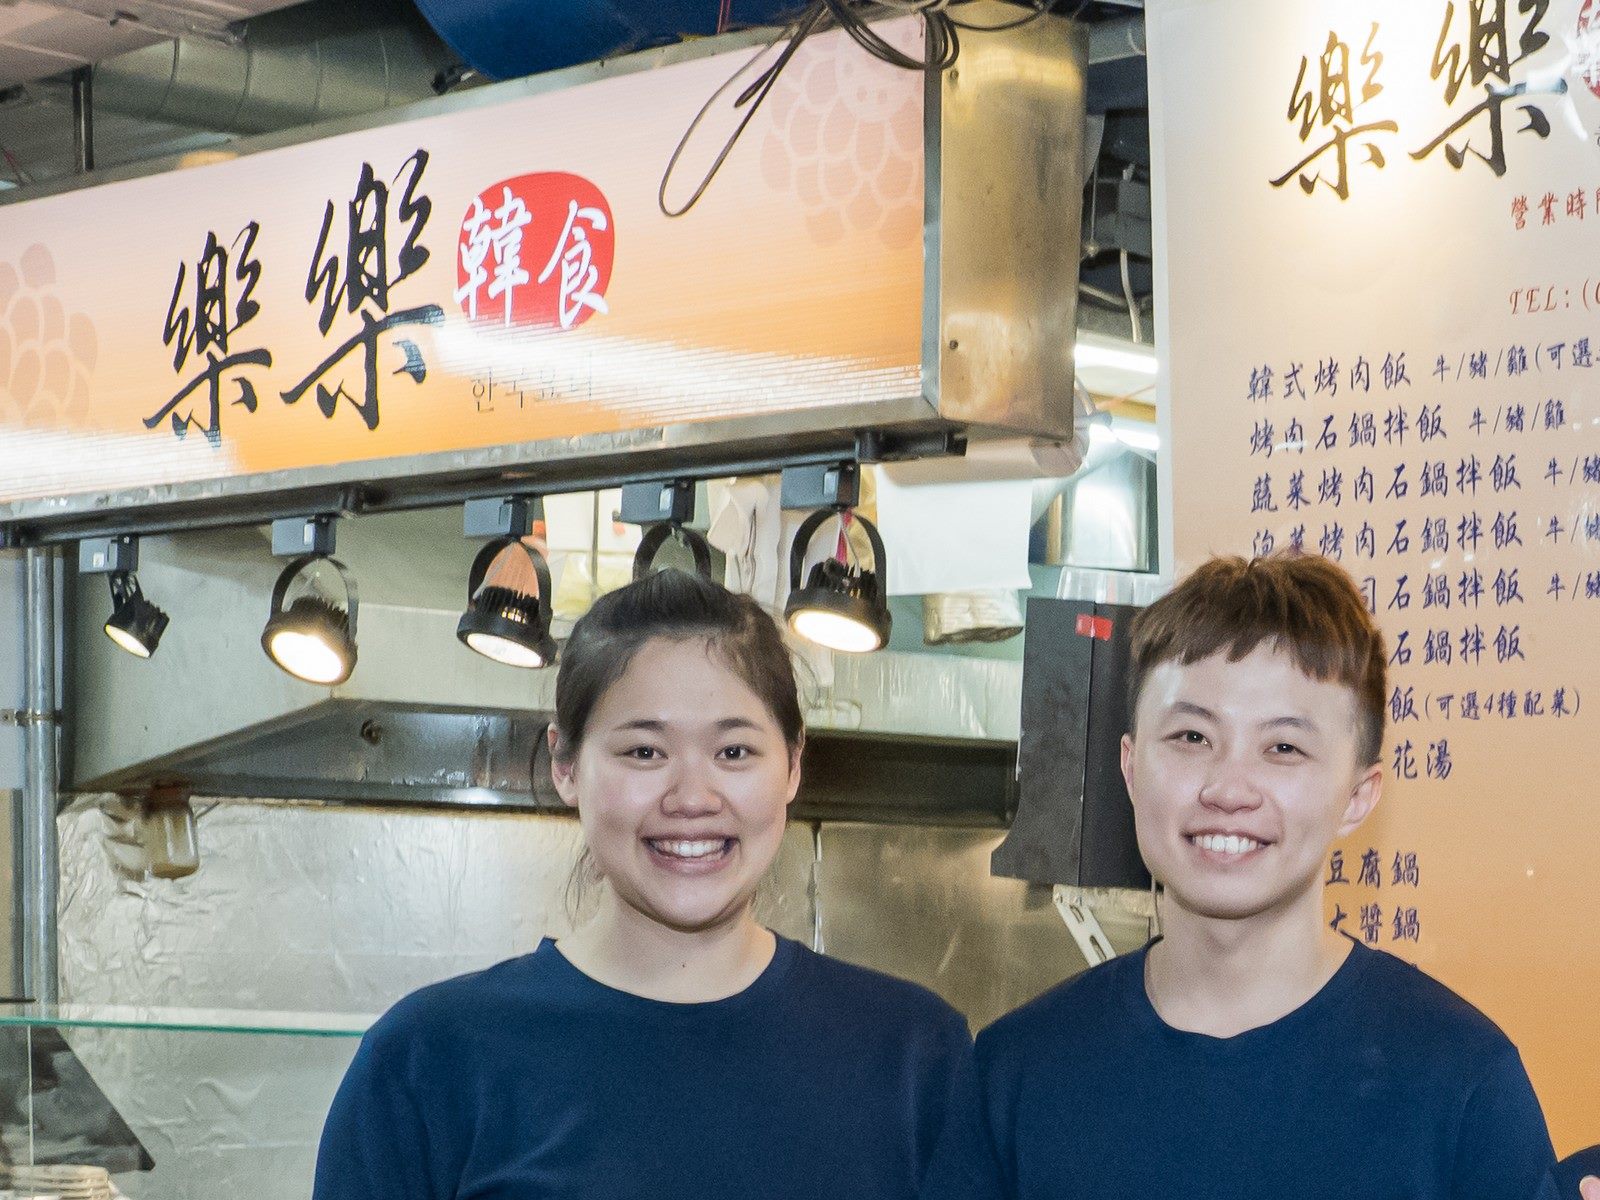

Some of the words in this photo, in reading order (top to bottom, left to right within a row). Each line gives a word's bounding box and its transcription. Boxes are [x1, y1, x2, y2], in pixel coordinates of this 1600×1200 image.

[143, 148, 444, 447] 樂樂
[453, 185, 610, 331] 韓食
[1247, 351, 1412, 404] 韓式烤肉飯
[1249, 404, 1448, 458] 烤肉石鍋拌飯
[1468, 398, 1567, 433] 牛/豬/雞
[1251, 455, 1522, 513] 蔬菜烤肉石鍋拌飯
[1389, 624, 1526, 667] 石鍋拌飯
[1392, 740, 1453, 781] 花湯
[1325, 848, 1419, 889] 豆腐鍋
